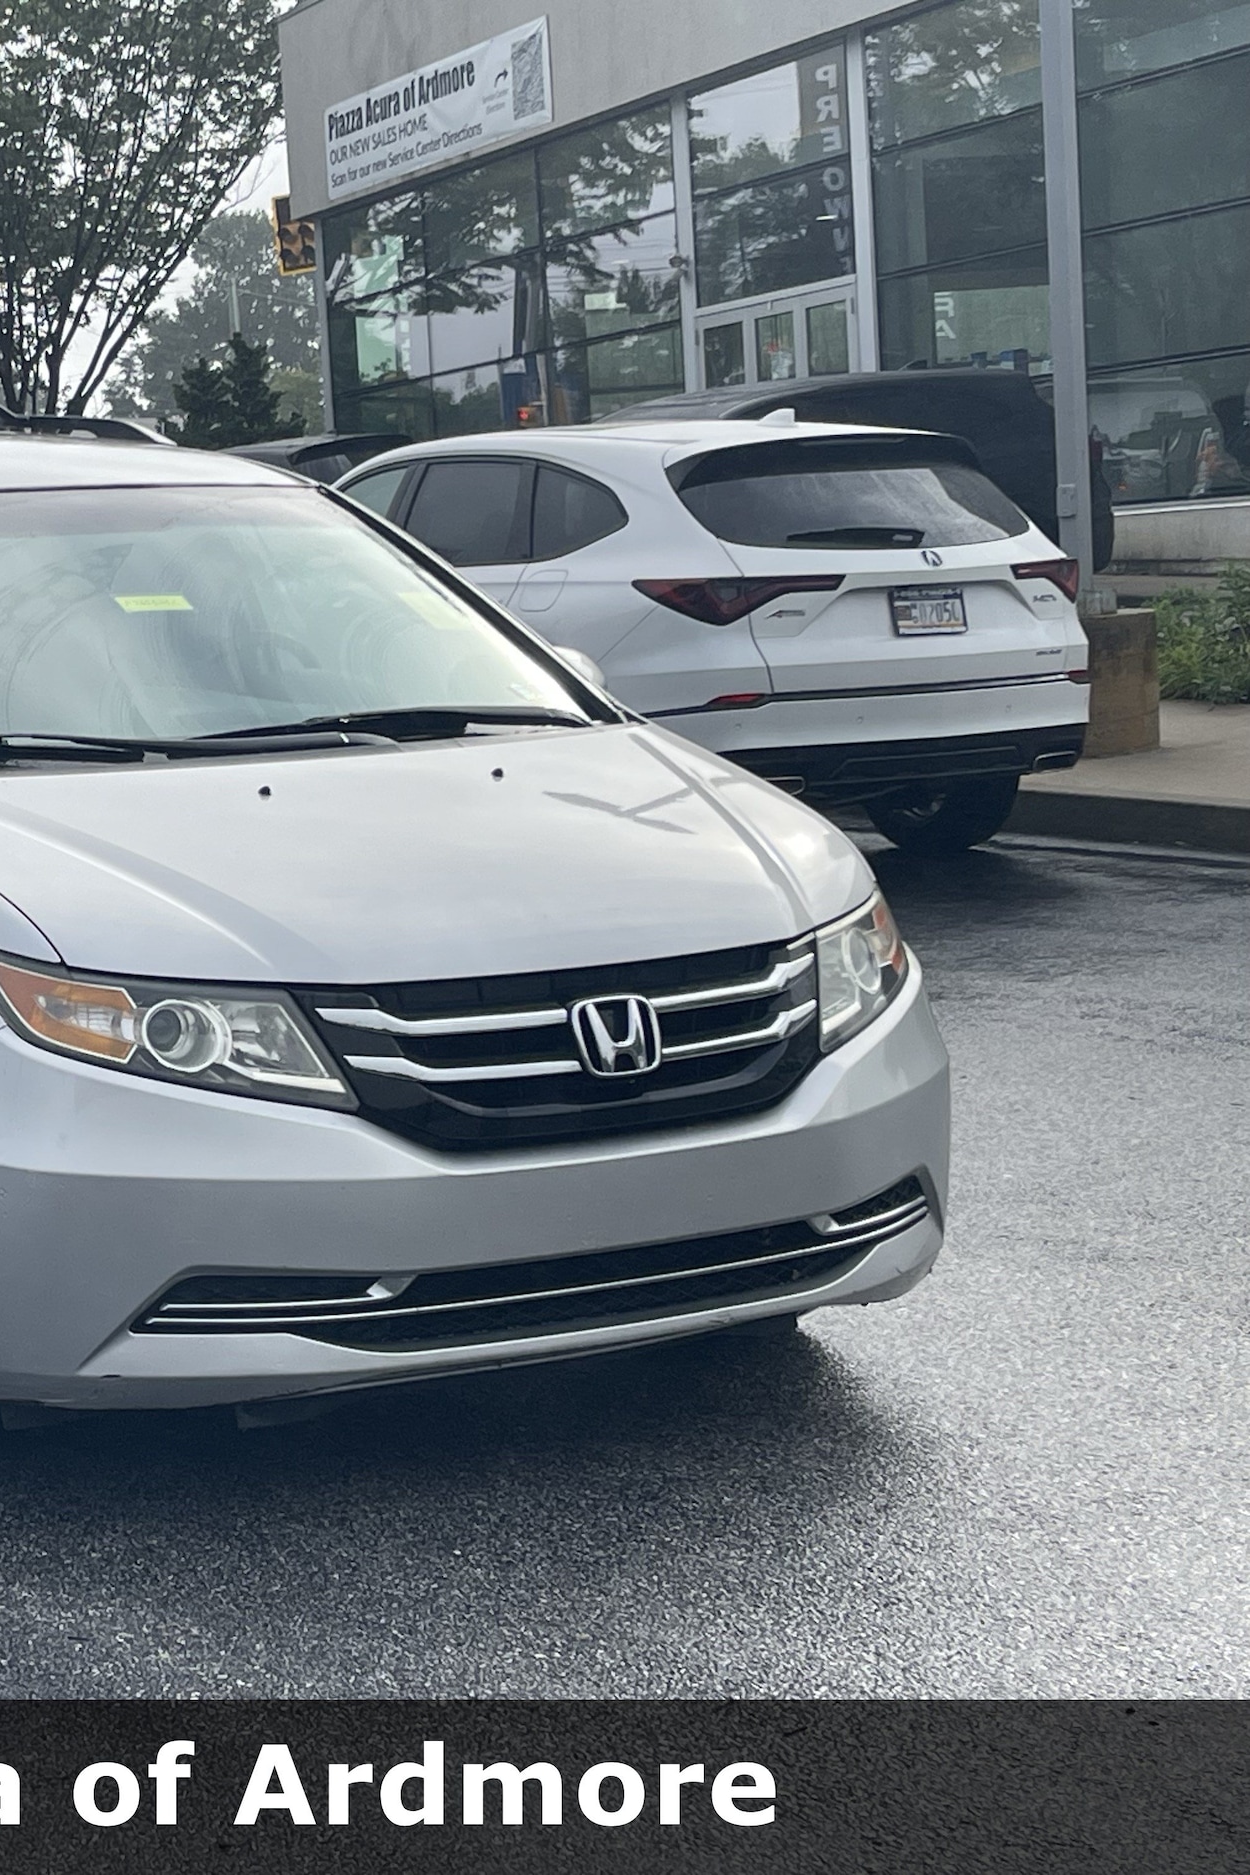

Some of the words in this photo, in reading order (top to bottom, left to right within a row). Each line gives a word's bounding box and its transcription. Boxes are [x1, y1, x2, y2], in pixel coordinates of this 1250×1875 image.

[328, 105, 364, 142] Piazza
[366, 90, 401, 129] Acura
[403, 77, 417, 113] of
[418, 60, 475, 107] Ardmore
[330, 142, 348, 166] OUR
[349, 137, 370, 159] NEW
[372, 126, 397, 151] SALES
[399, 112, 428, 139] HOME
[331, 170, 348, 188] Scan
[388, 146, 415, 169] Service
[416, 136, 441, 159] Center
[443, 122, 482, 148] Directions
